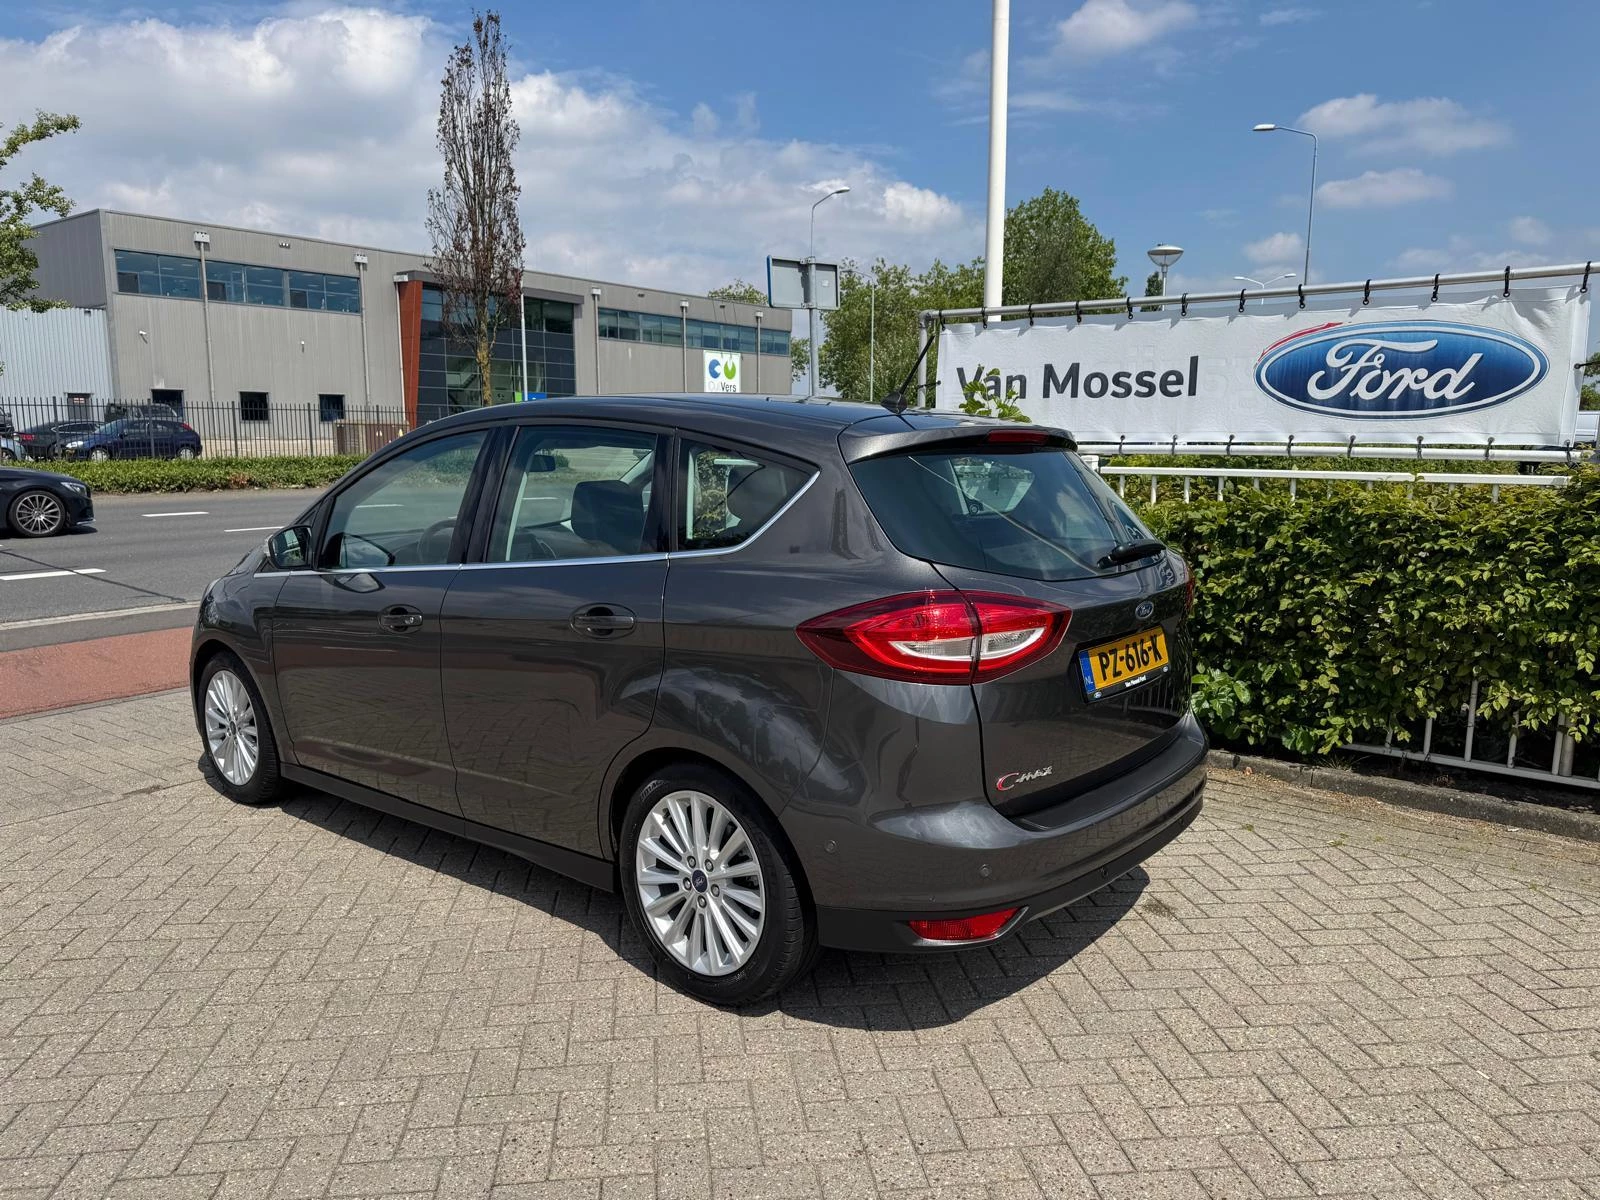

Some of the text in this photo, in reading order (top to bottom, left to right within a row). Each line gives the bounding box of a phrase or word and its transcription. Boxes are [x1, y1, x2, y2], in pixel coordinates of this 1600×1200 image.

[957, 355, 1199, 400] Van Mossel
[1307, 338, 1483, 400] Ford
[1098, 634, 1163, 681] PZ-616-K
